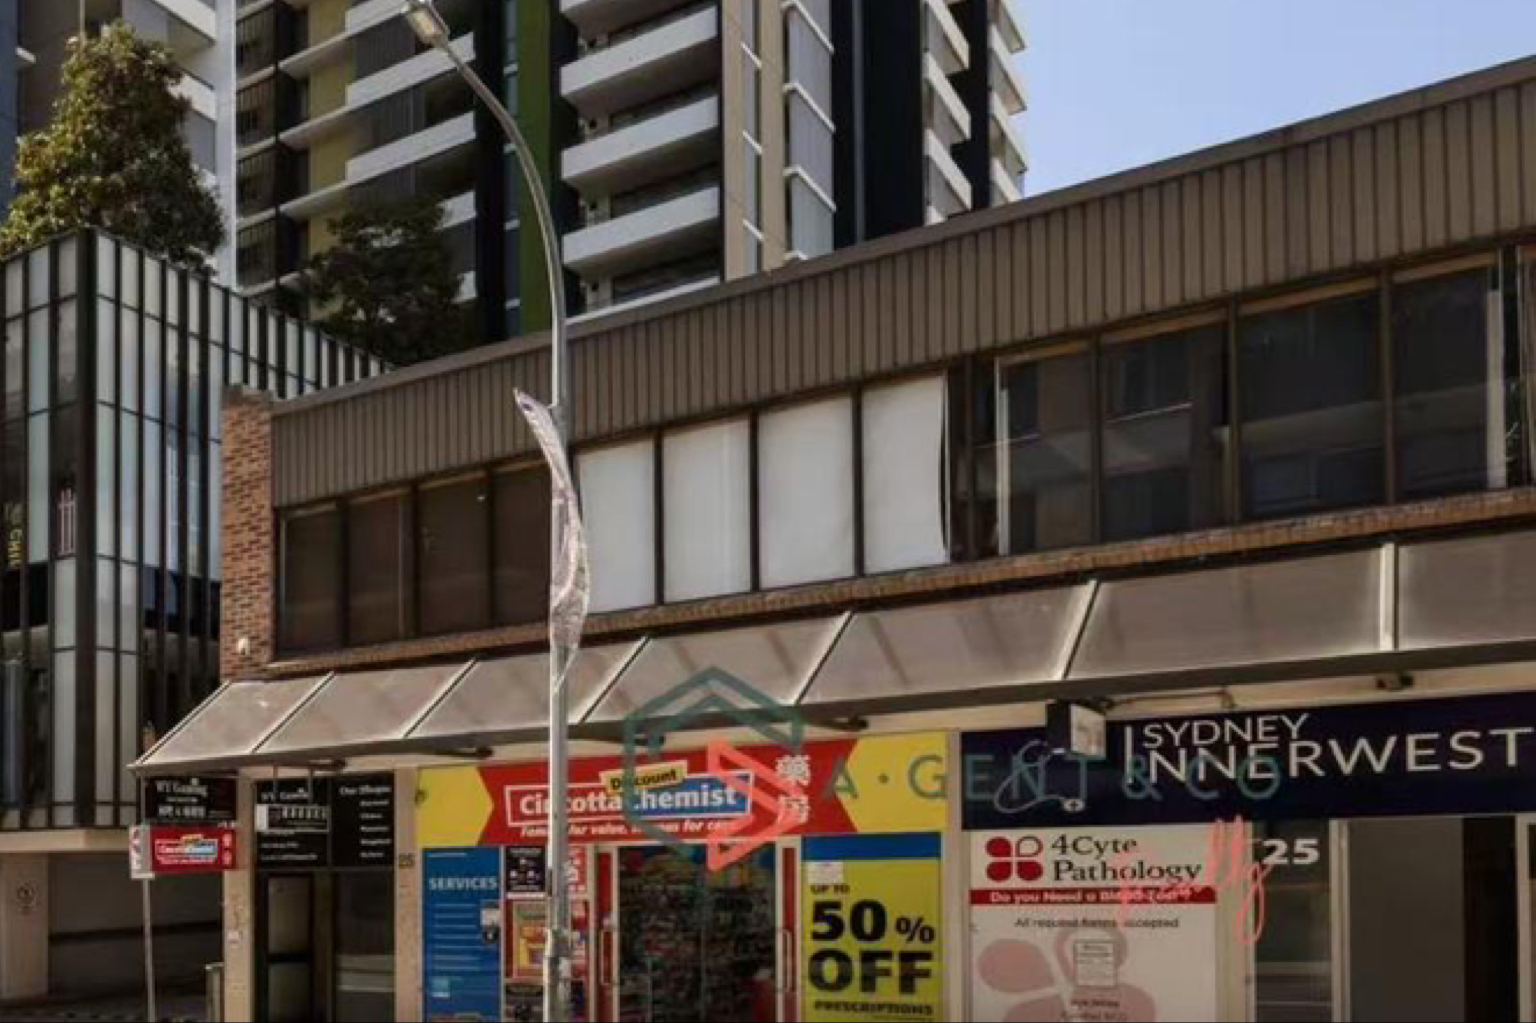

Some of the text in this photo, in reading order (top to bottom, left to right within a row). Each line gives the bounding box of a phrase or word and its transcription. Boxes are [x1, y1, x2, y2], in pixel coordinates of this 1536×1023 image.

[1142, 712, 1309, 748] SYDNEY
[610, 768, 677, 791] Dcount
[682, 818, 704, 833] for
[1051, 833, 1138, 859] 4Cyte
[1262, 838, 1320, 865] 25
[1052, 860, 1202, 883] Pathology
[428, 876, 498, 891] SERVICES
[990, 890, 1011, 903] Do
[1014, 893, 1040, 905] you
[808, 948, 933, 994] OFF
